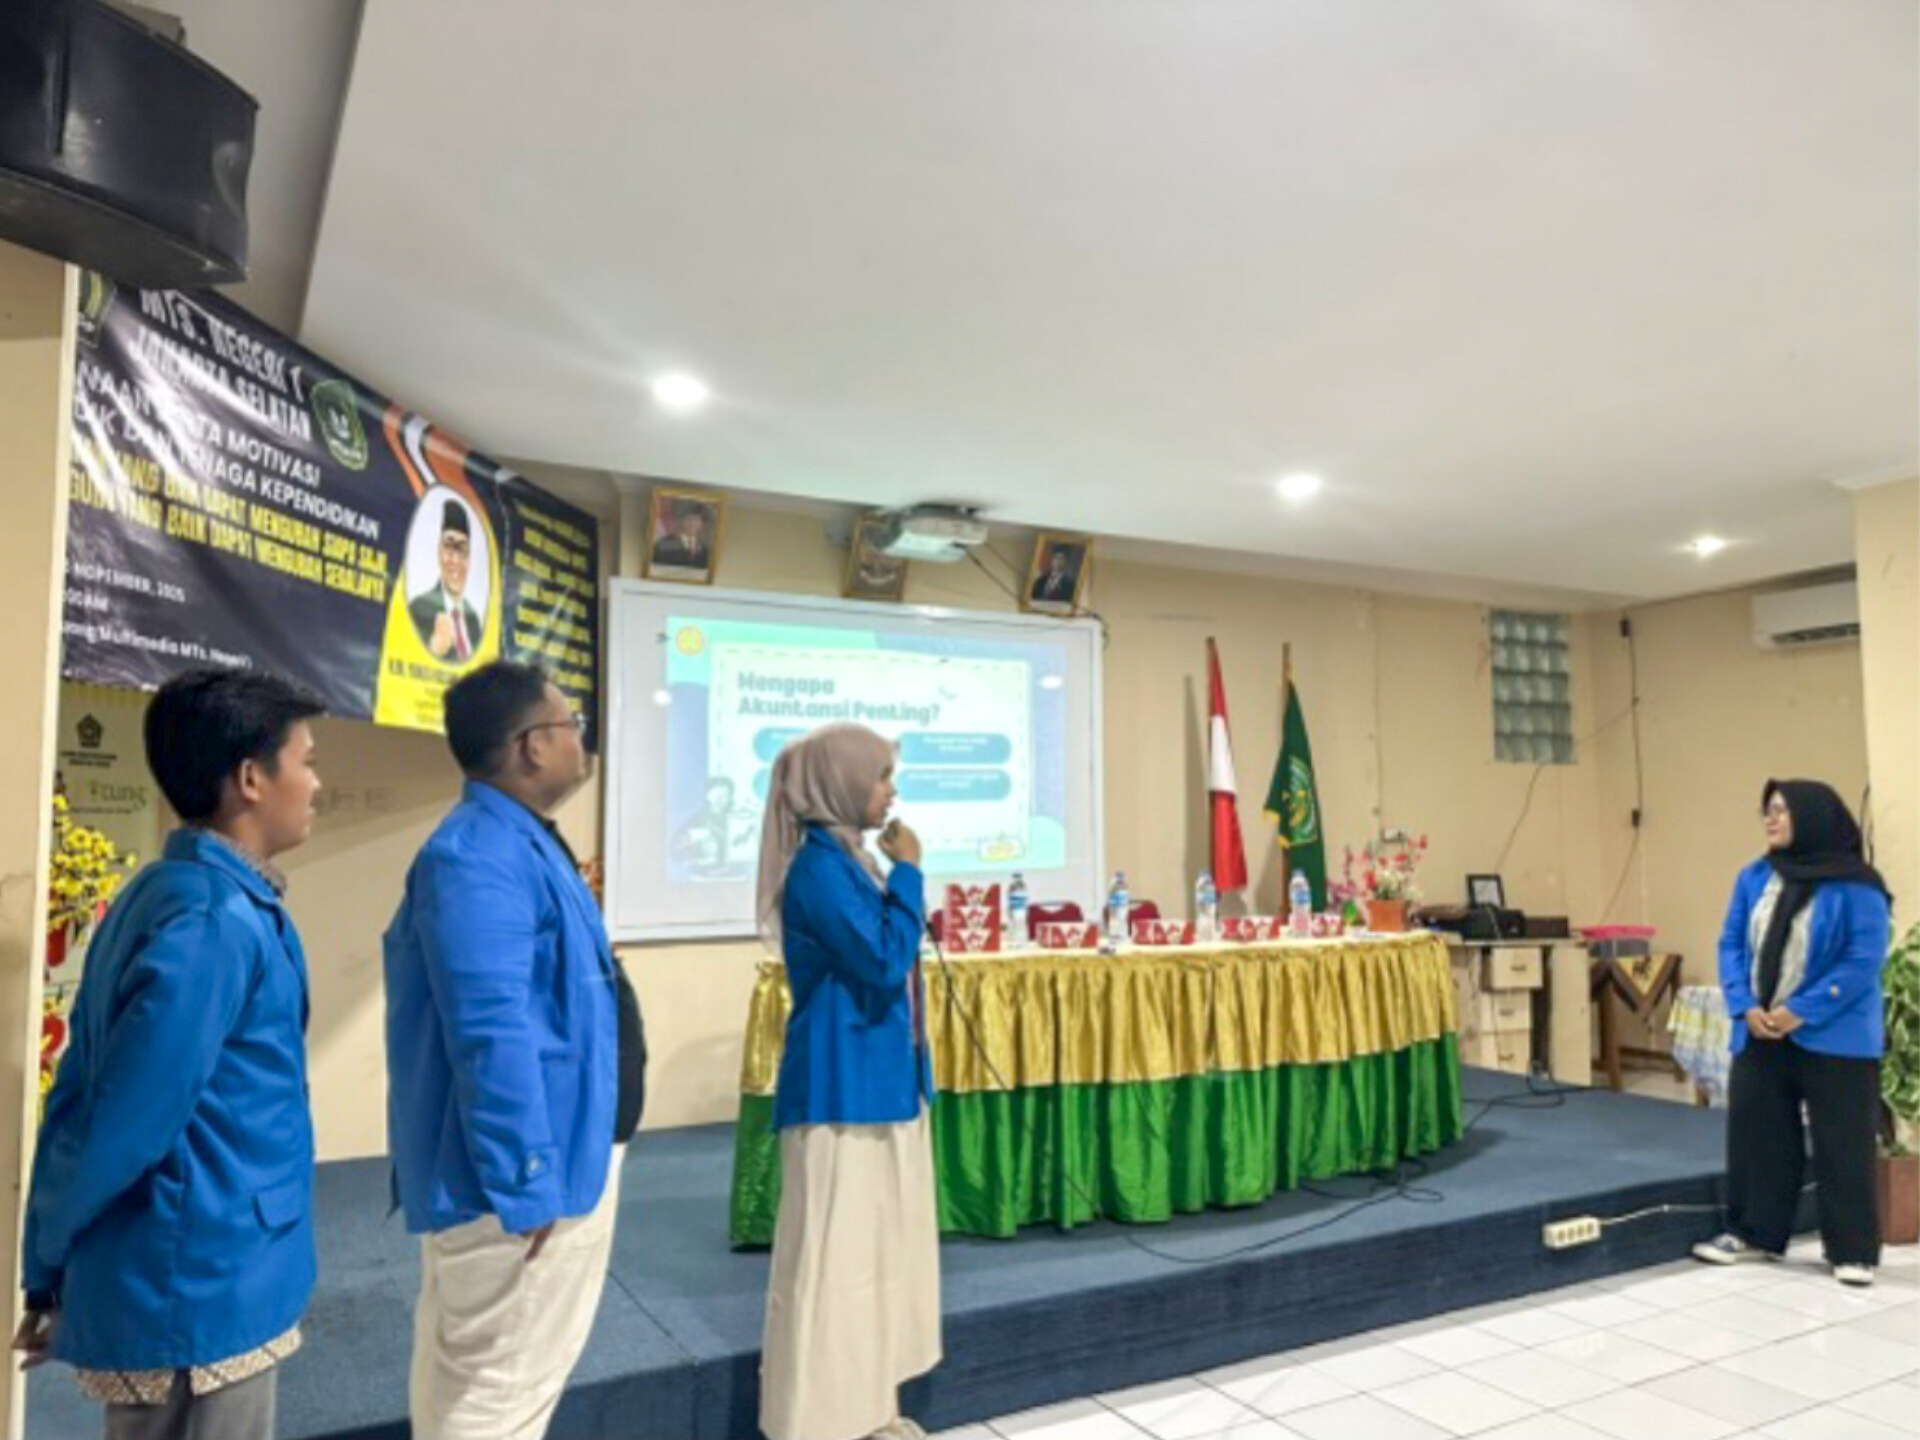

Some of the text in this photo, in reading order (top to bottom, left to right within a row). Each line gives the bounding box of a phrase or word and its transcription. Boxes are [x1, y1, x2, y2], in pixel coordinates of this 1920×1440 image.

[234, 374, 311, 441] SELATAN
[228, 429, 321, 488] MOTIVASI
[260, 474, 381, 540] KEPENDIDIKAN
[737, 671, 835, 698] Mengapa
[737, 696, 940, 726] Akuntansi Penting?
